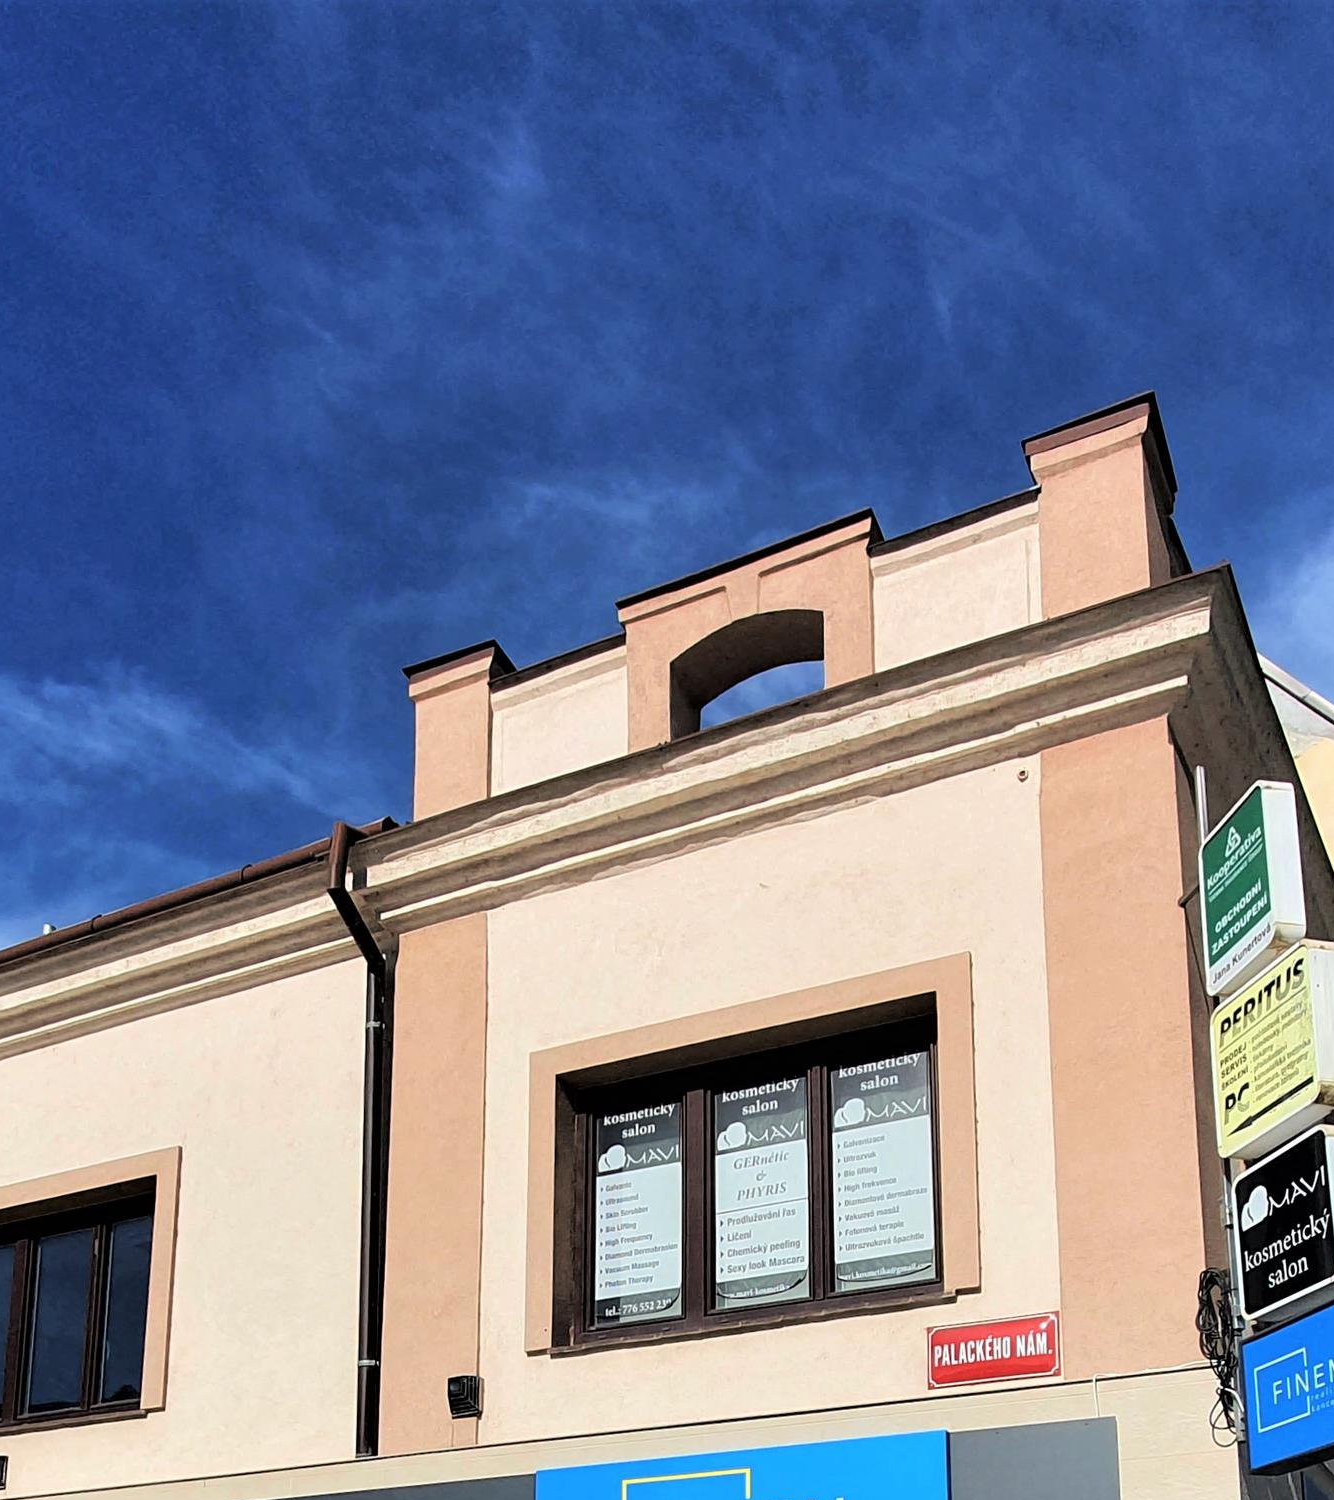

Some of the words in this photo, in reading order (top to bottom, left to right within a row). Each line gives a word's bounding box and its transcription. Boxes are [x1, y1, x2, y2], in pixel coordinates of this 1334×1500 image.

[1207, 826, 1261, 890] Kooperativa
[1215, 878, 1262, 933] OBCHODNÍ
[1211, 893, 1268, 955] ZASTOUPENÍ
[1213, 963, 1231, 984] Jana
[1232, 924, 1271, 964] Kunertová
[1220, 958, 1304, 1048] PERITUS
[1220, 1042, 1248, 1066] PRODEJ
[1221, 1054, 1247, 1079] SERVIS
[860, 1073, 899, 1091] salon
[742, 1099, 778, 1115] salon
[866, 1096, 927, 1122] MAVI
[1224, 1082, 1250, 1125] PC
[622, 1122, 656, 1139] salon
[747, 1121, 804, 1145] MAVI
[625, 1144, 679, 1168] MAVI
[733, 1150, 790, 1170] GERnétic
[843, 1151, 876, 1164] Ultrazvuk
[737, 1182, 787, 1201] PHYRIS
[844, 1182, 860, 1193] High
[1268, 1165, 1326, 1217] MAVI
[727, 1210, 780, 1227] Prodlužování
[782, 1208, 796, 1218] řas
[605, 1237, 619, 1249] High
[620, 1233, 653, 1247] Frequency
[727, 1243, 768, 1258] Chemický
[769, 1239, 801, 1255] peeling
[1244, 1207, 1331, 1272] kosmetický
[631, 1260, 660, 1273] Massage
[727, 1263, 747, 1275] Sexy
[748, 1259, 767, 1270] look
[769, 1255, 805, 1267] Mascara
[1267, 1256, 1309, 1288] salon
[628, 1274, 654, 1287] Therapy
[622, 1303, 638, 1315] 776
[640, 1301, 655, 1312] 552
[934, 1335, 1011, 1367] PALACKÉHO
[1016, 1330, 1053, 1357] NÁM.
